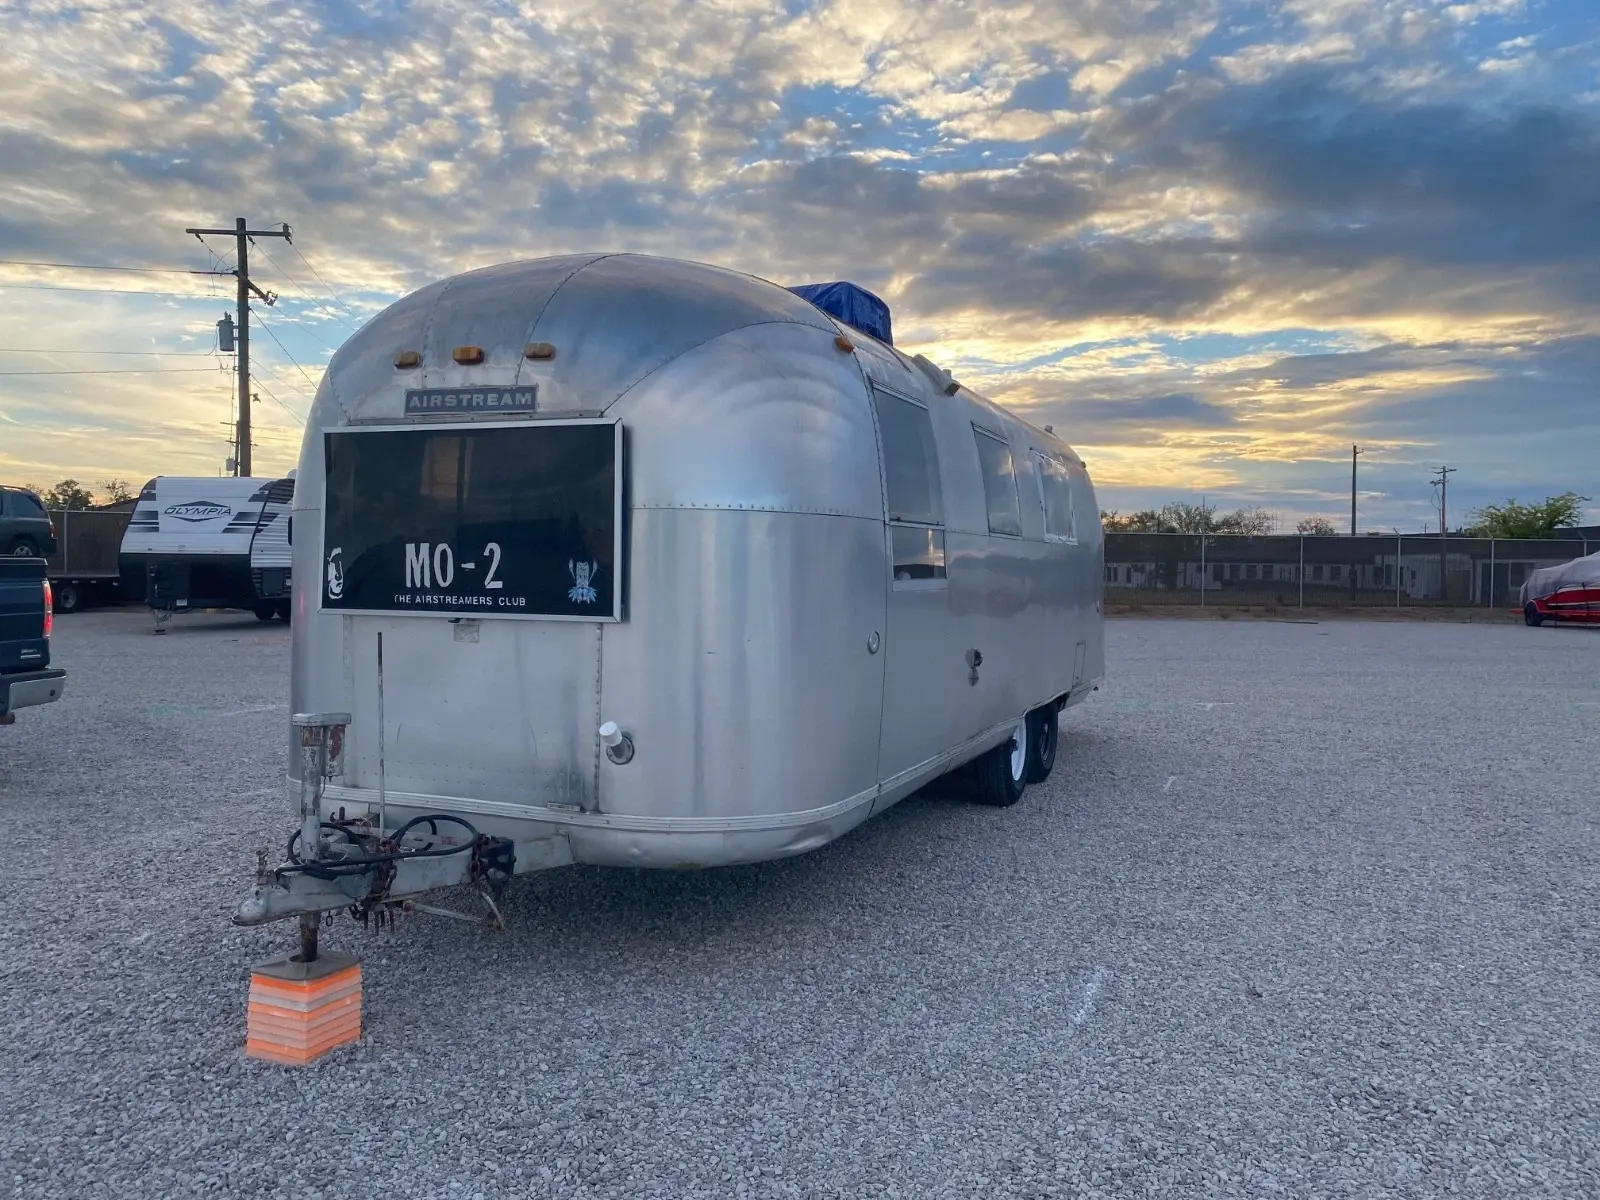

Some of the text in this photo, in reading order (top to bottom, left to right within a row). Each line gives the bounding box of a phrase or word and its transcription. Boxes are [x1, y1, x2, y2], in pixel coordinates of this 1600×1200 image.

[409, 393, 532, 408] AIRSTREAM
[164, 507, 232, 515] OLYMPIA
[415, 595, 493, 606] AIRSTREAMERS
[498, 596, 526, 606] CLUB
